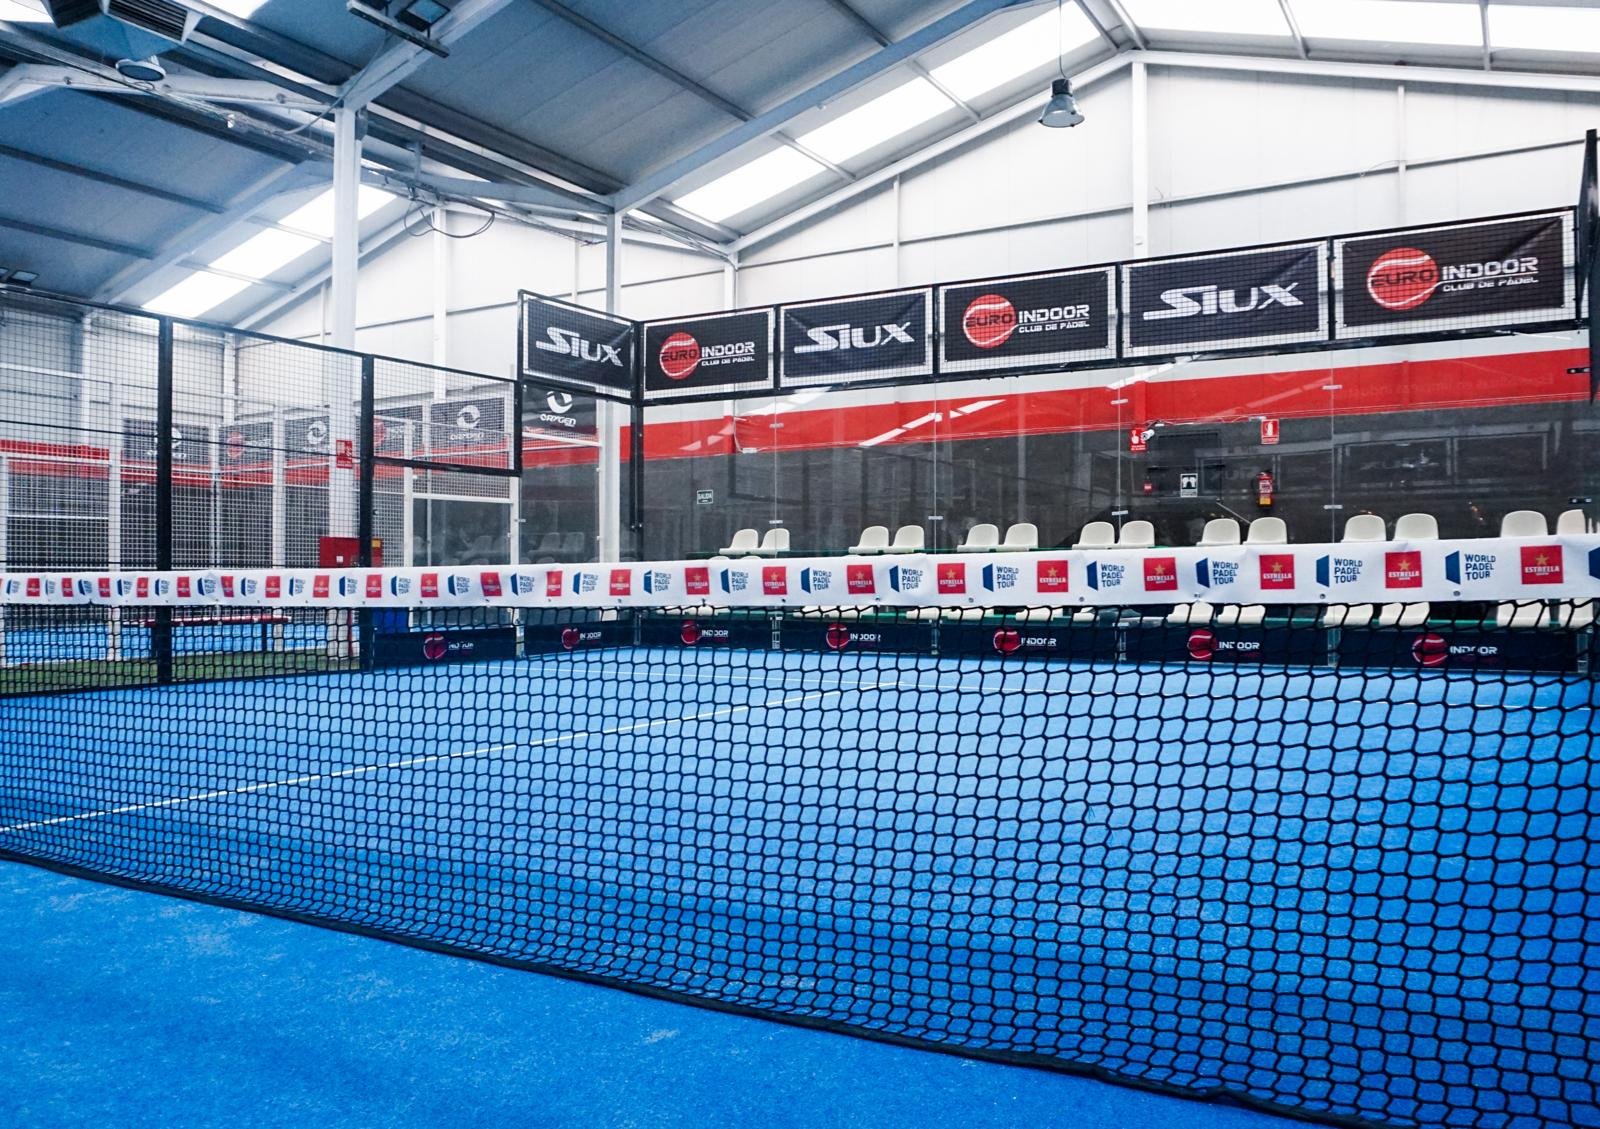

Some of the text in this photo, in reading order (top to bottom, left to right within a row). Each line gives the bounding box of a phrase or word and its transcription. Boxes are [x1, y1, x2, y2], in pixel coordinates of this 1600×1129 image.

[1371, 257, 1539, 287] EURO INDOOR
[1442, 283, 1474, 292] CLUB
[1478, 281, 1495, 289] DE
[965, 304, 1090, 328] EURO INDOOR
[1018, 325, 1043, 333] CLUB
[1045, 323, 1057, 331] DE
[662, 341, 755, 362] EURO INDOOR
[1334, 558, 1362, 567] WORLD
[1464, 553, 1496, 563] WORLD
[1101, 563, 1125, 572] WORLD
[1212, 561, 1239, 569] WORLD
[1465, 562, 1494, 571] PADEL
[1524, 565, 1560, 573] ESTRELLA
[901, 568, 923, 576] WORLD
[996, 566, 1019, 574] WORLD
[1213, 569, 1237, 577] PADEL
[1334, 566, 1360, 575] PADEL
[1388, 570, 1419, 578] ESTRELLA
[1101, 571, 1123, 579] PADEL
[1334, 574, 1357, 584] TOUR
[1466, 571, 1490, 580] TOUR
[997, 580, 1014, 589] TOUR
[1101, 579, 1121, 587] TOUR
[1213, 577, 1234, 585] TOUR
[902, 582, 919, 590] TOUR
